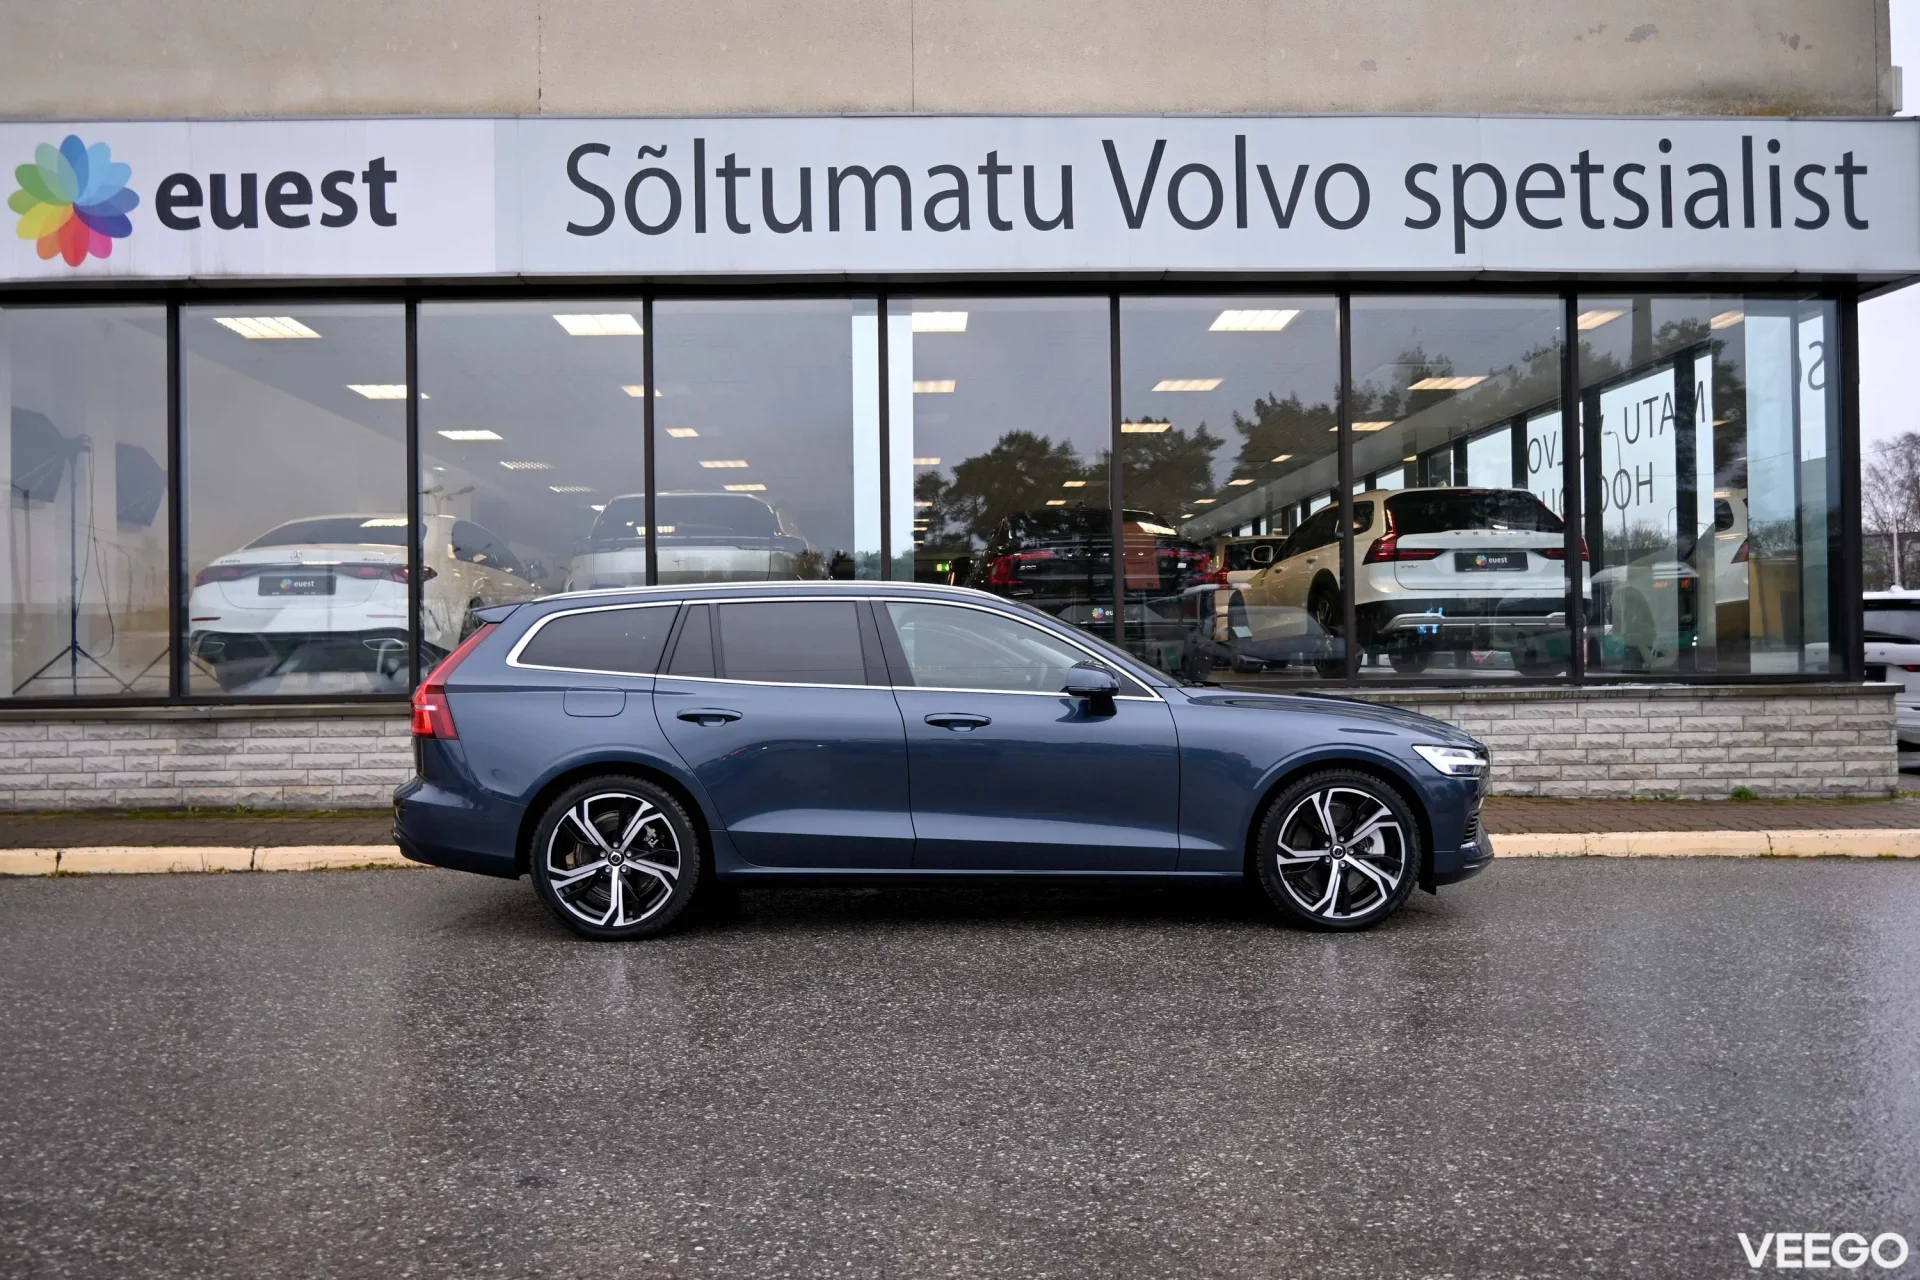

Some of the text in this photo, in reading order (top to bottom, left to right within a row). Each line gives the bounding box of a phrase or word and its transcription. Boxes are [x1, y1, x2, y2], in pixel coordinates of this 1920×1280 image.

[155, 156, 398, 231] euest
[566, 134, 1869, 255] Sõltumatu Volvo spetsialist
[1488, 556, 1508, 564] euest
[293, 580, 315, 588] euest
